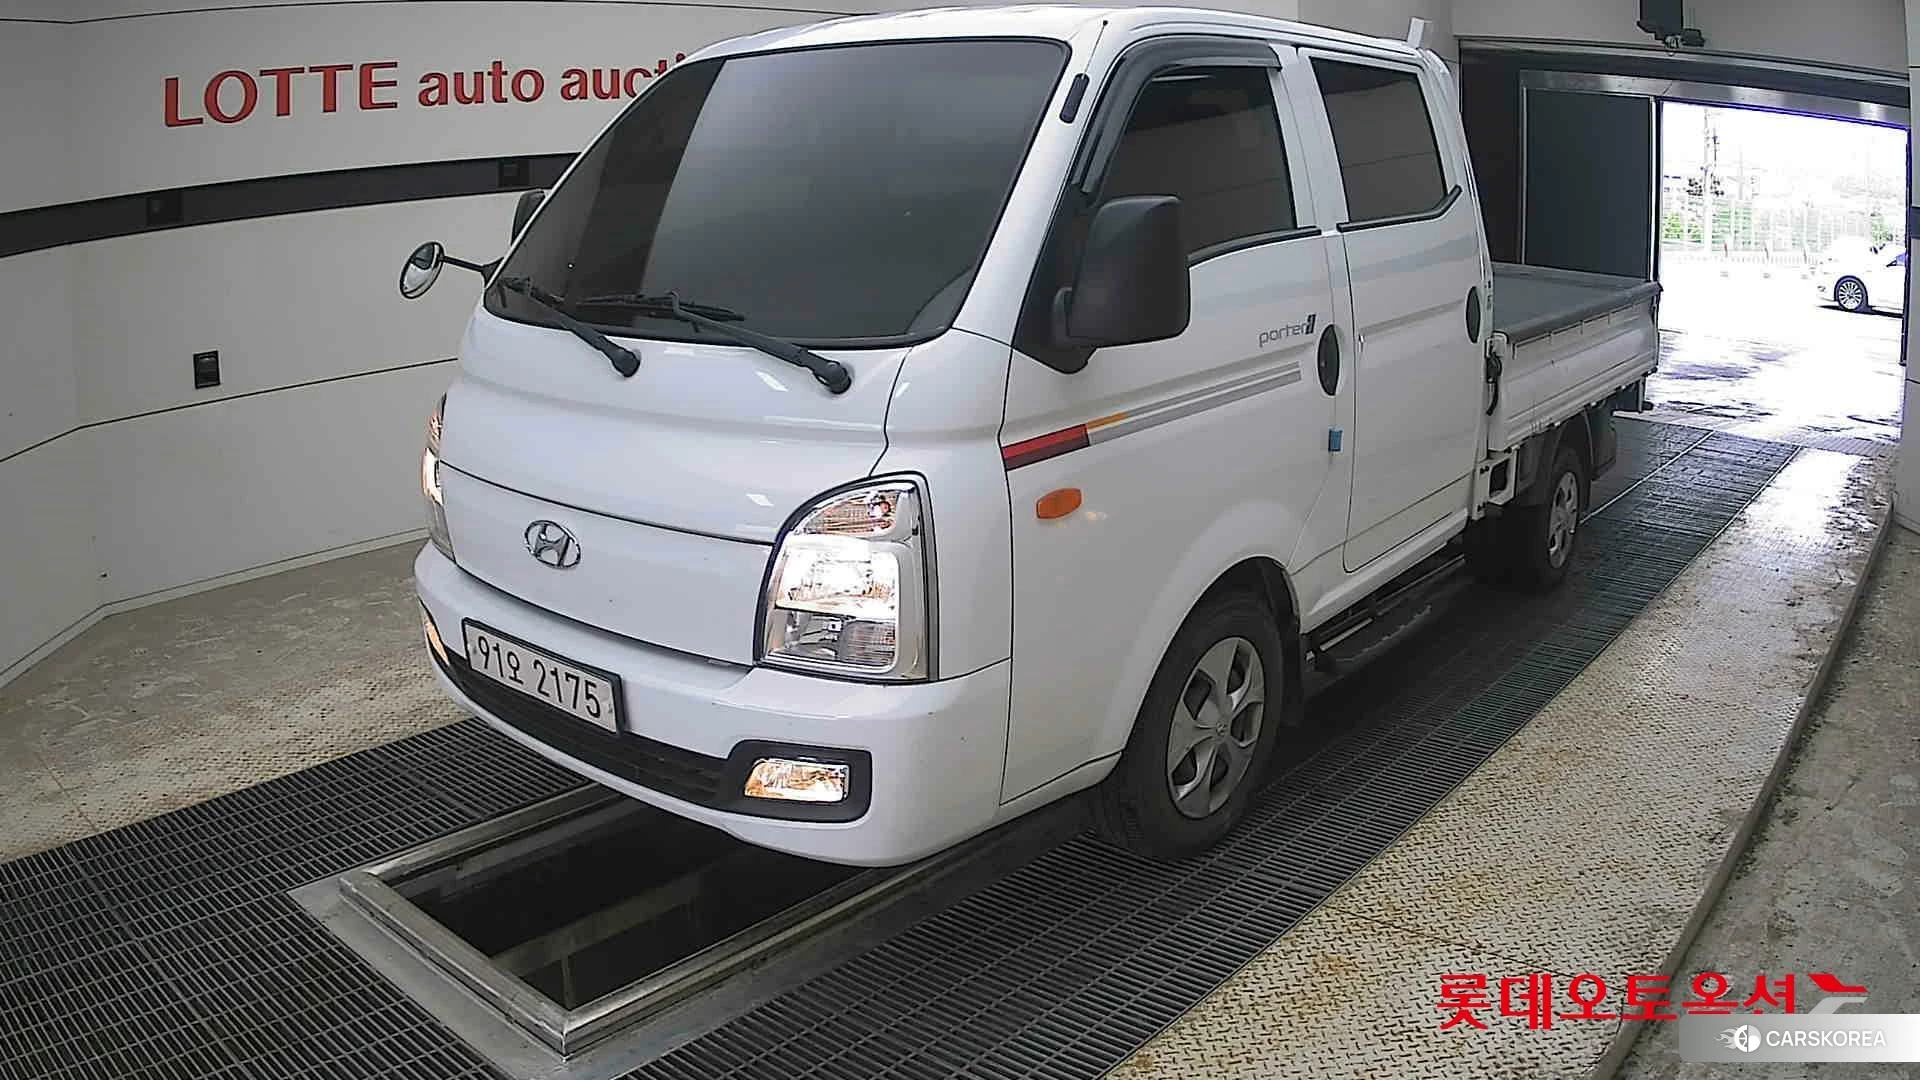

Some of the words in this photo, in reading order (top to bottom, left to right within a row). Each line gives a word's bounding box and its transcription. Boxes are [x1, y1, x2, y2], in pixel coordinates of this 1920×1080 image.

[164, 61, 399, 128] LOTTE
[418, 60, 545, 107] auto
[478, 635, 524, 686] 91오
[533, 659, 601, 719] 2175
